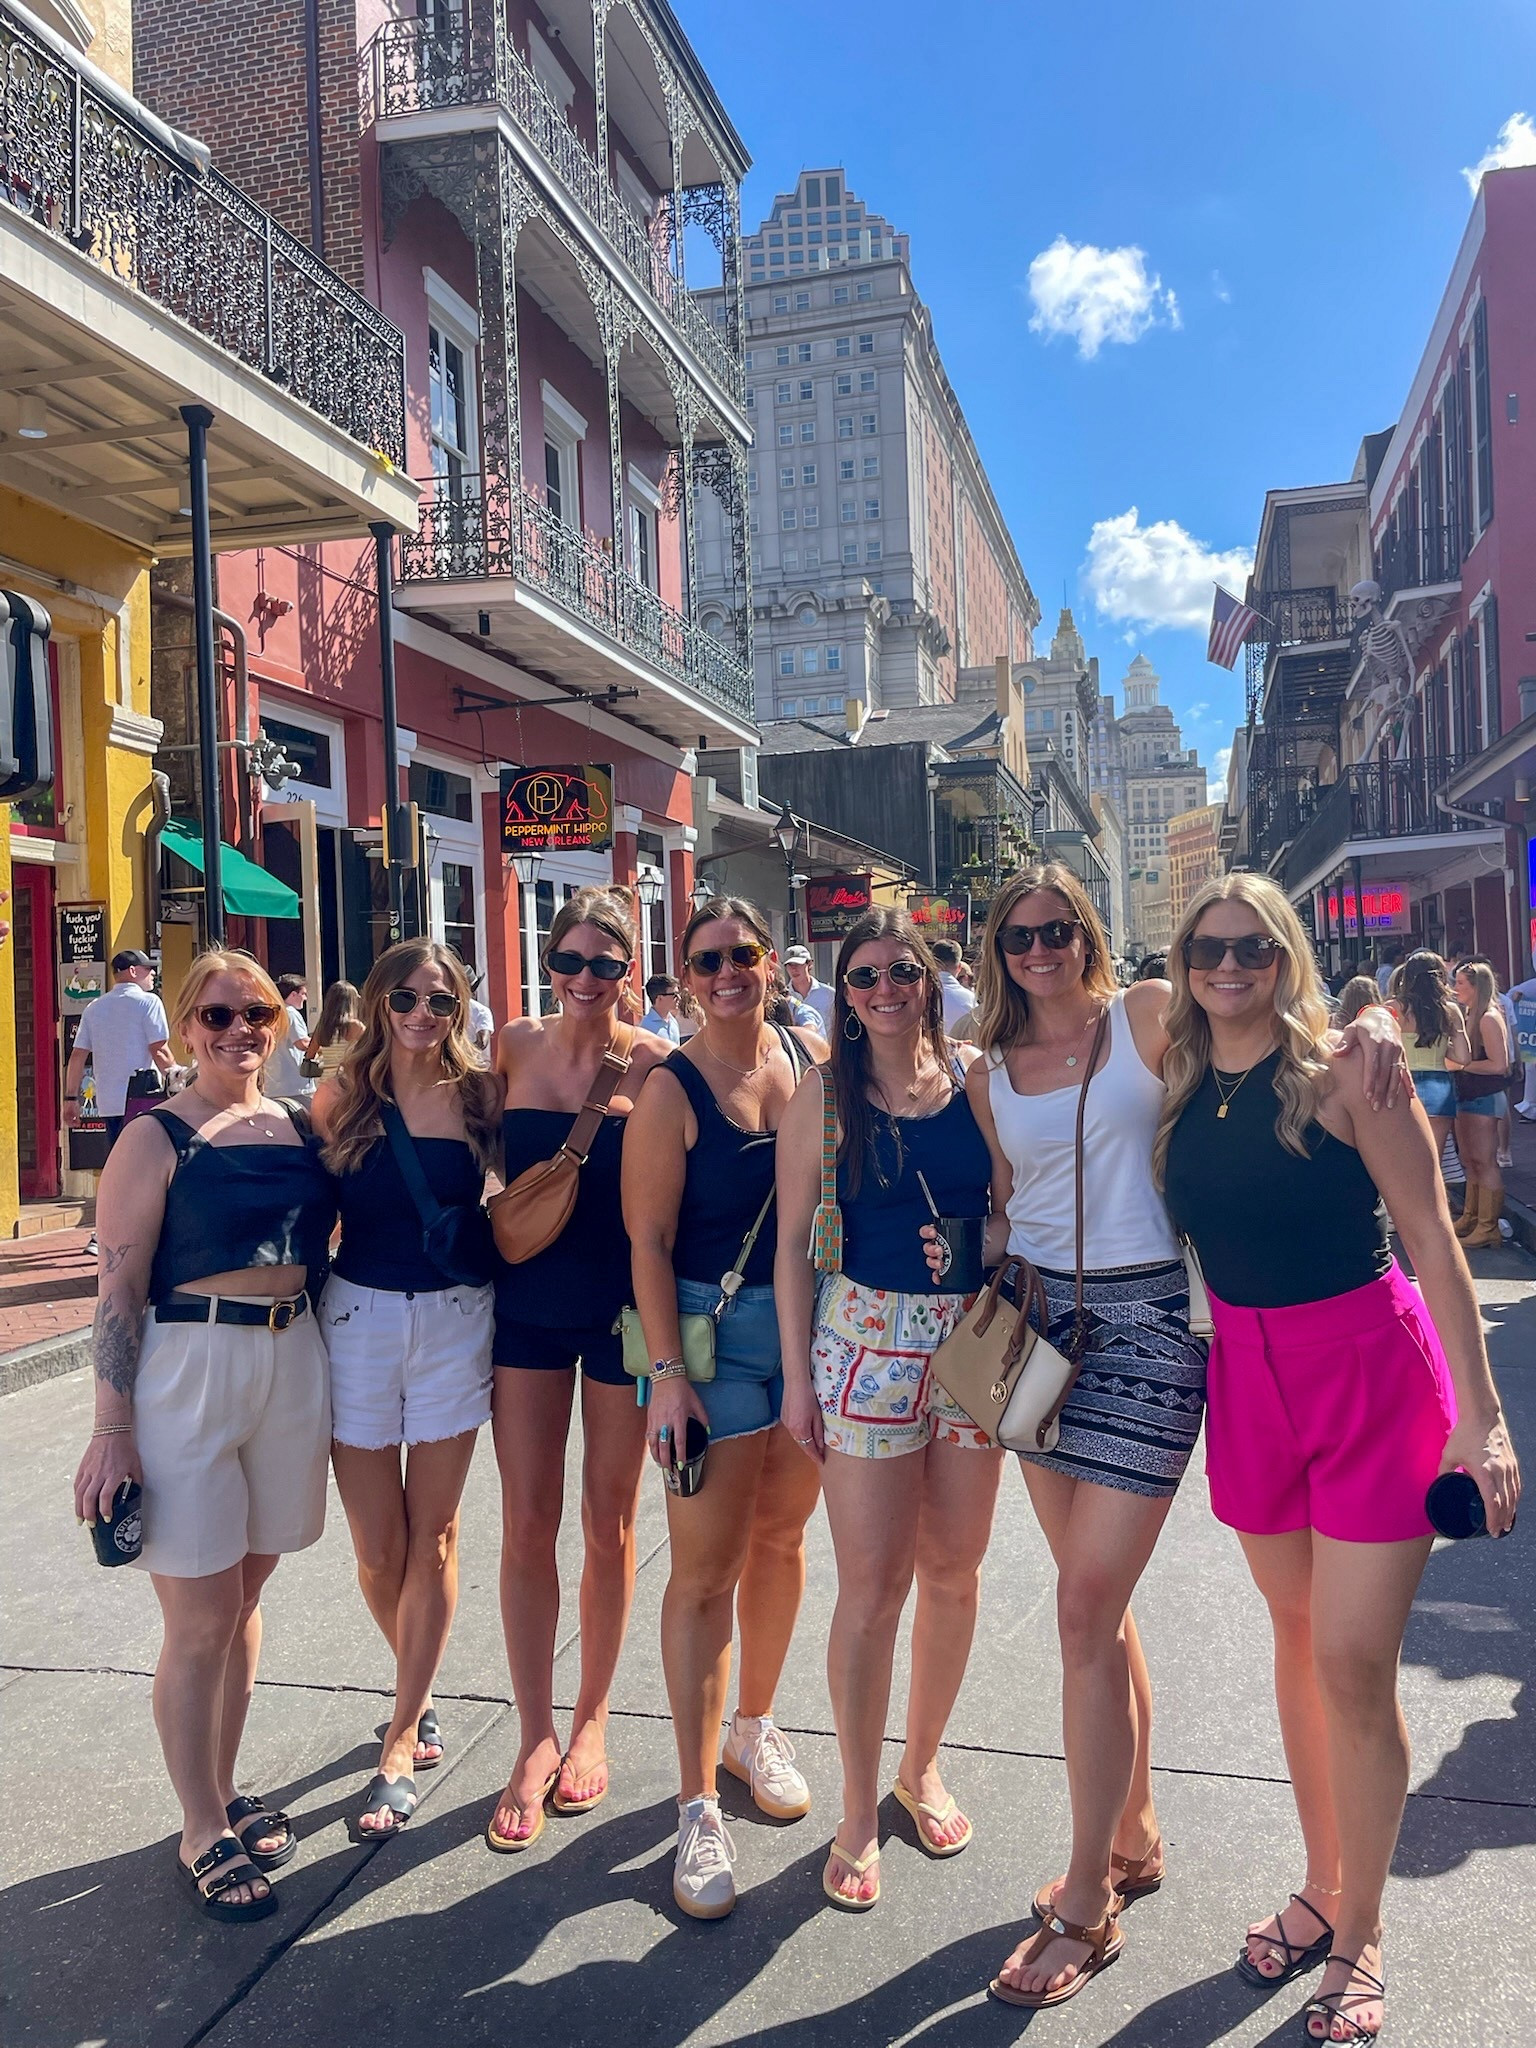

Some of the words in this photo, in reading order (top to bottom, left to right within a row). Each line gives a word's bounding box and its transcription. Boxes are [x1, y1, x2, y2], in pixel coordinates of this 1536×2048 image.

[505, 823, 571, 837] PEPPERMINT
[573, 822, 608, 834] HIPPO
[521, 837, 545, 847] NEW
[546, 834, 592, 846] ORLEANS
[66, 913, 84, 923] fuck
[85, 913, 101, 924] you
[911, 909, 932, 924] BIG
[936, 906, 966, 923] EASY
[73, 924, 95, 934] YOU
[69, 933, 98, 944] fuckin'
[74, 943, 93, 954] fuck
